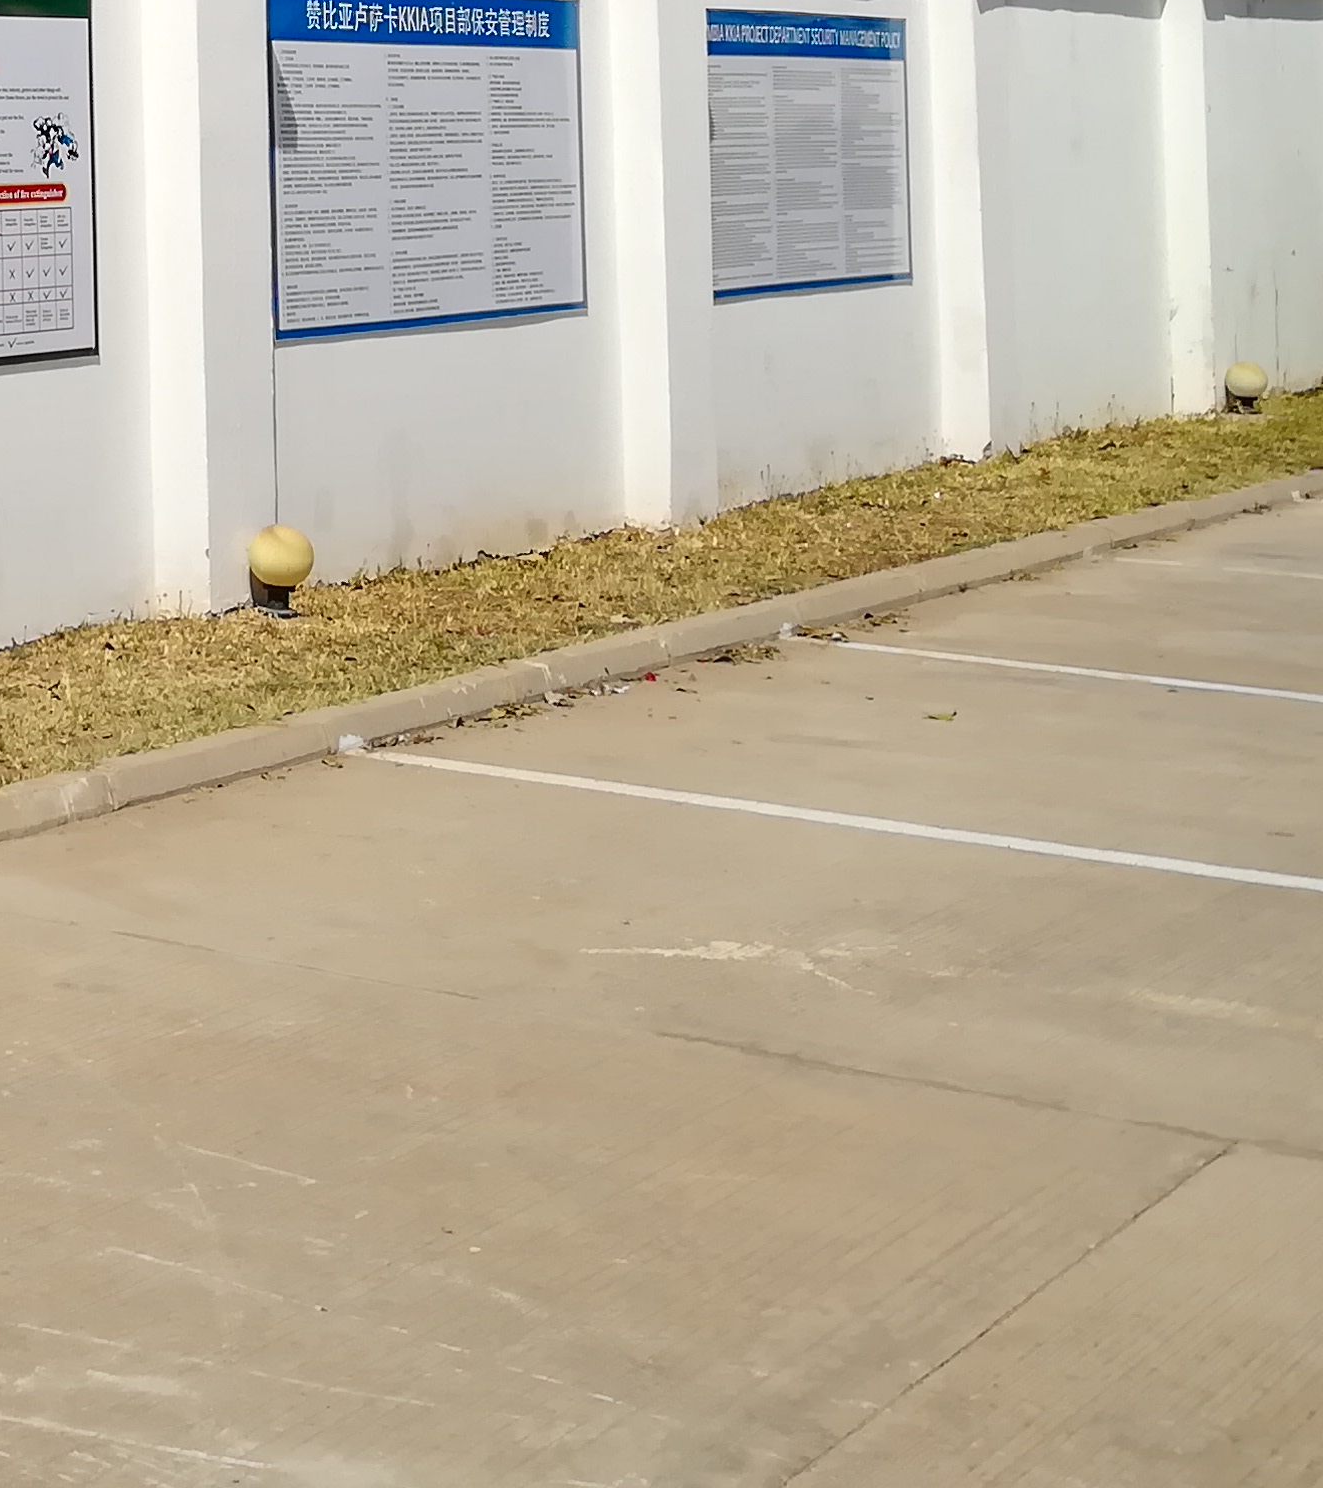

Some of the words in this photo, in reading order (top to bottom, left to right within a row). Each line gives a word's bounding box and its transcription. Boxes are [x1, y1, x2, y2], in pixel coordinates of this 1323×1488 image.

[307, 0, 551, 38] 赞比亚卢萨卡KKIA项目部保安管理制度
[811, 27, 838, 45] SECURITY
[14, 189, 20, 199] of
[21, 189, 30, 198] fire
